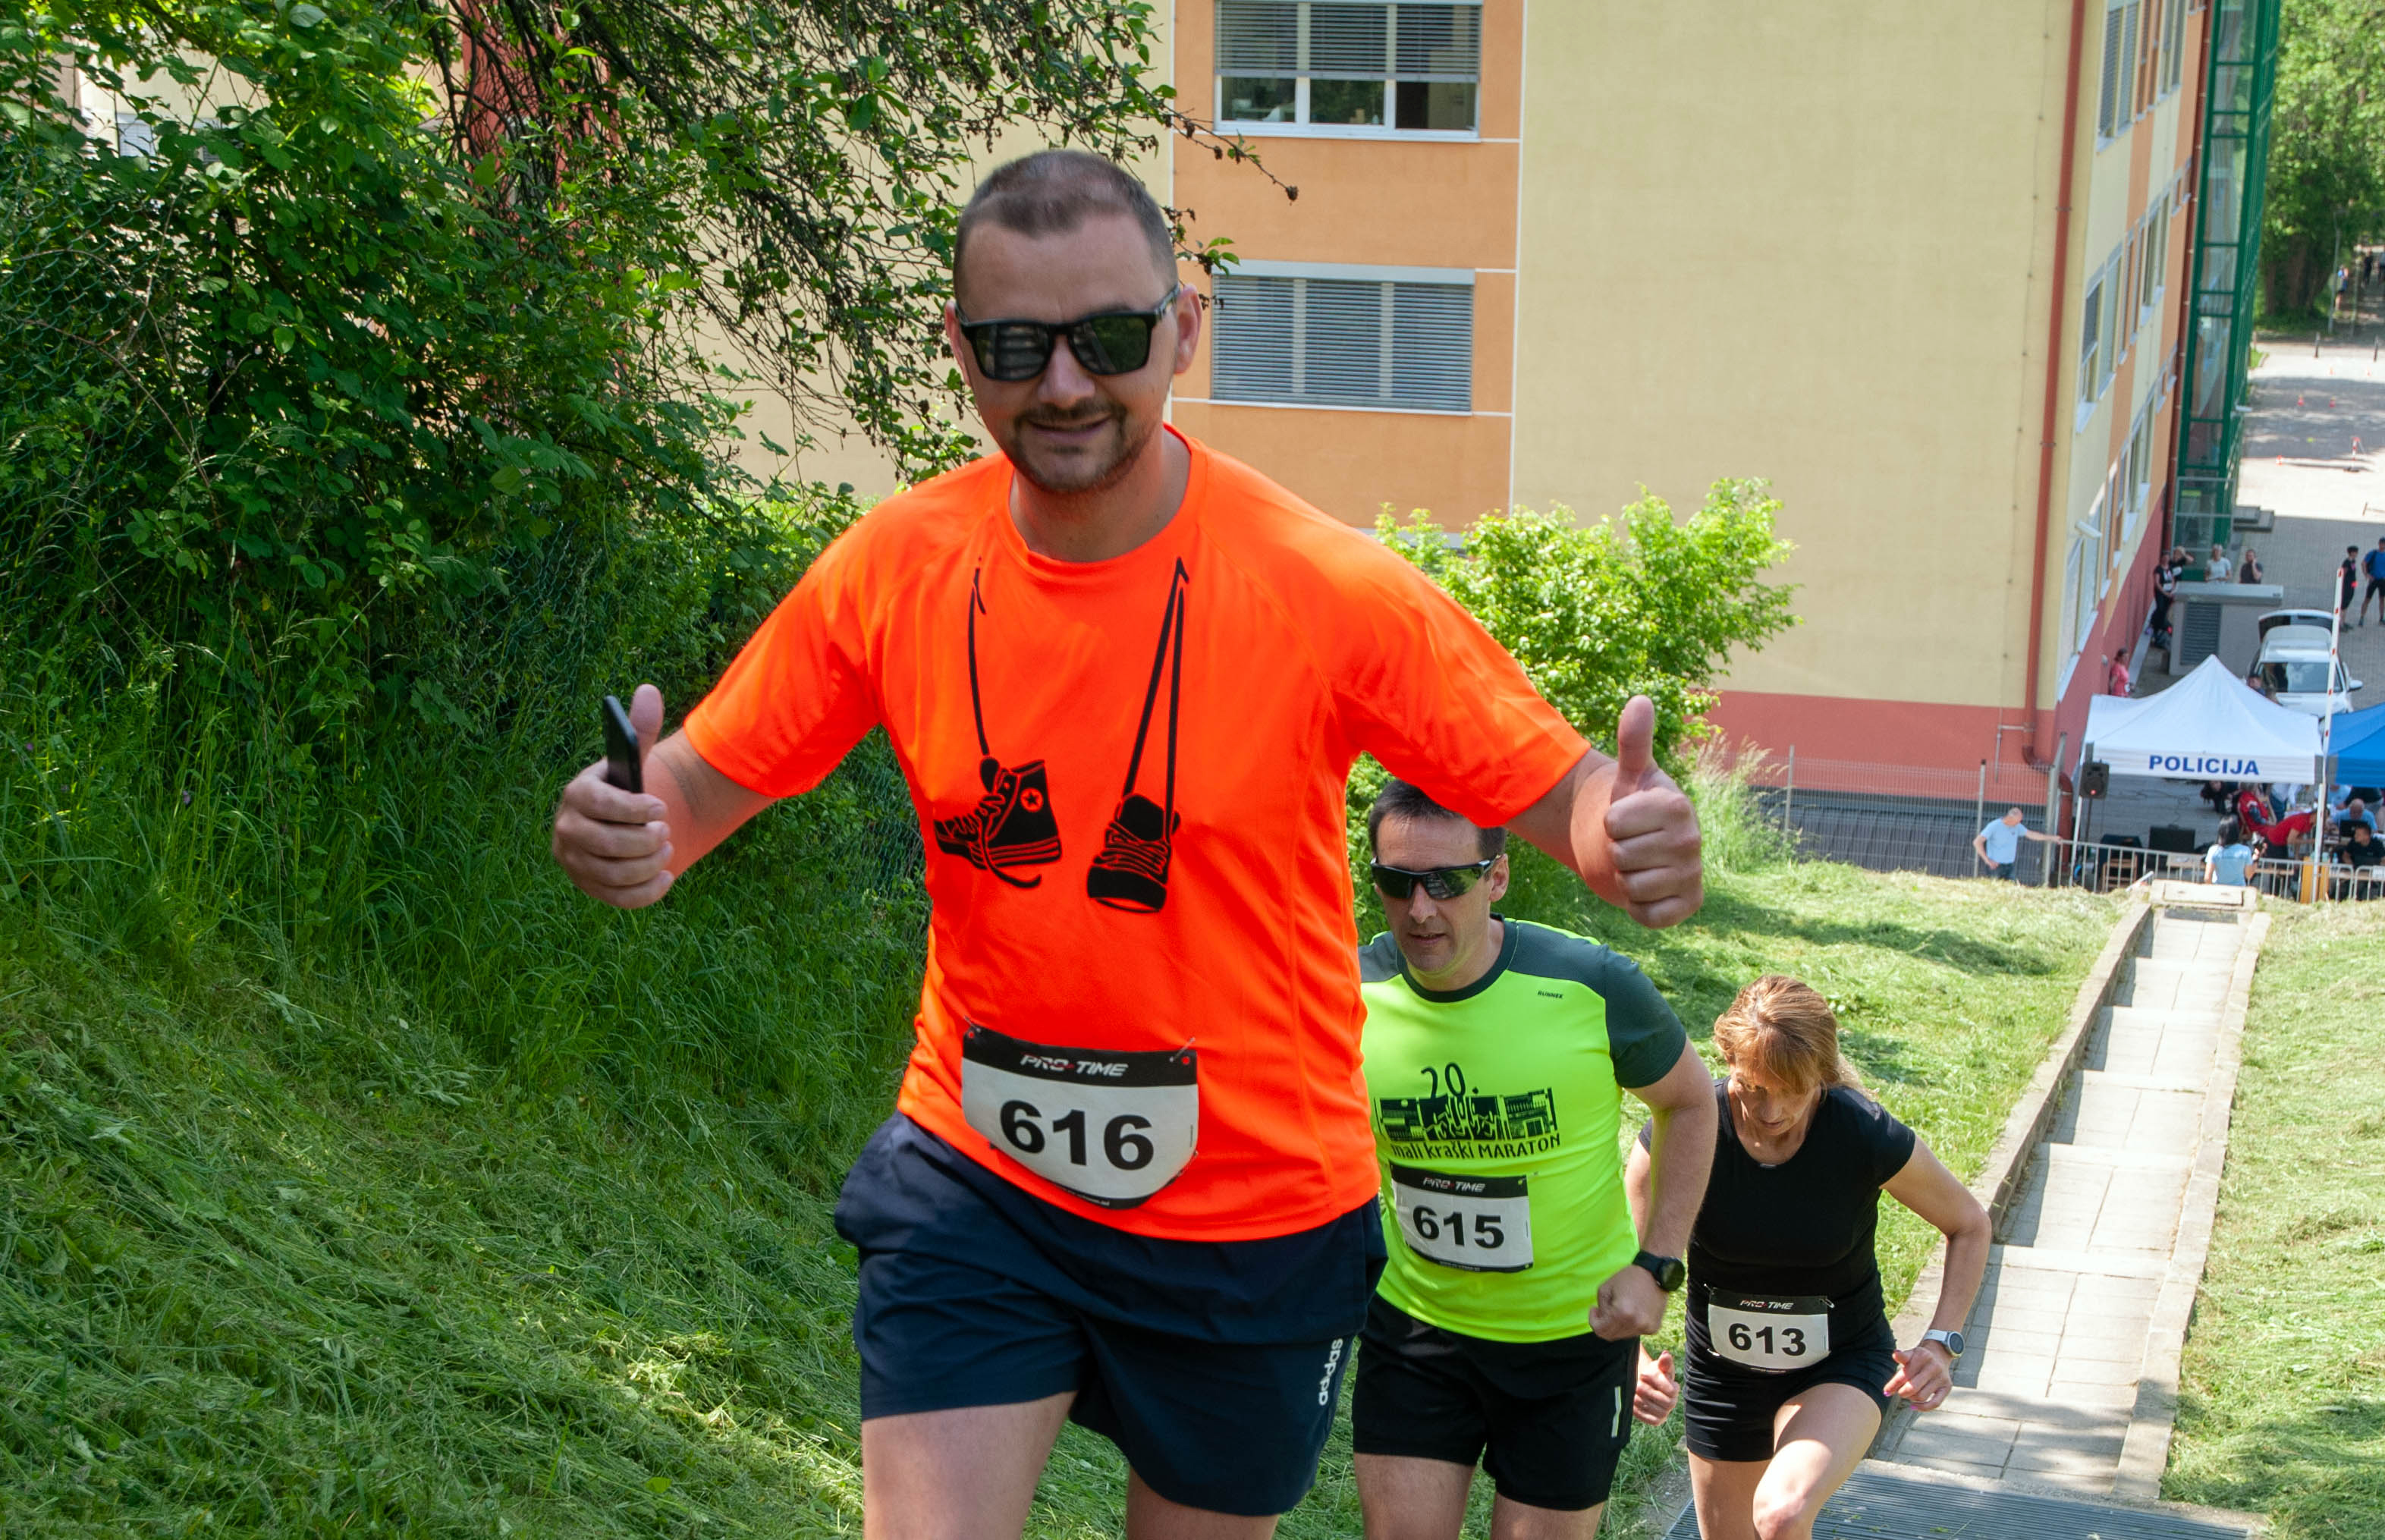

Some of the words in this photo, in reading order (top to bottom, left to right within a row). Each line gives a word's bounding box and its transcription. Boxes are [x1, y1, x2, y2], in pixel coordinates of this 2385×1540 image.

[2148, 754, 2260, 775] POLICIJA
[999, 1099, 1155, 1171] 616
[1478, 1133, 1560, 1159] MARATON
[1412, 1205, 1505, 1249] 615
[1728, 1322, 1807, 1356] 613
[1318, 1337, 1344, 1406] addas
